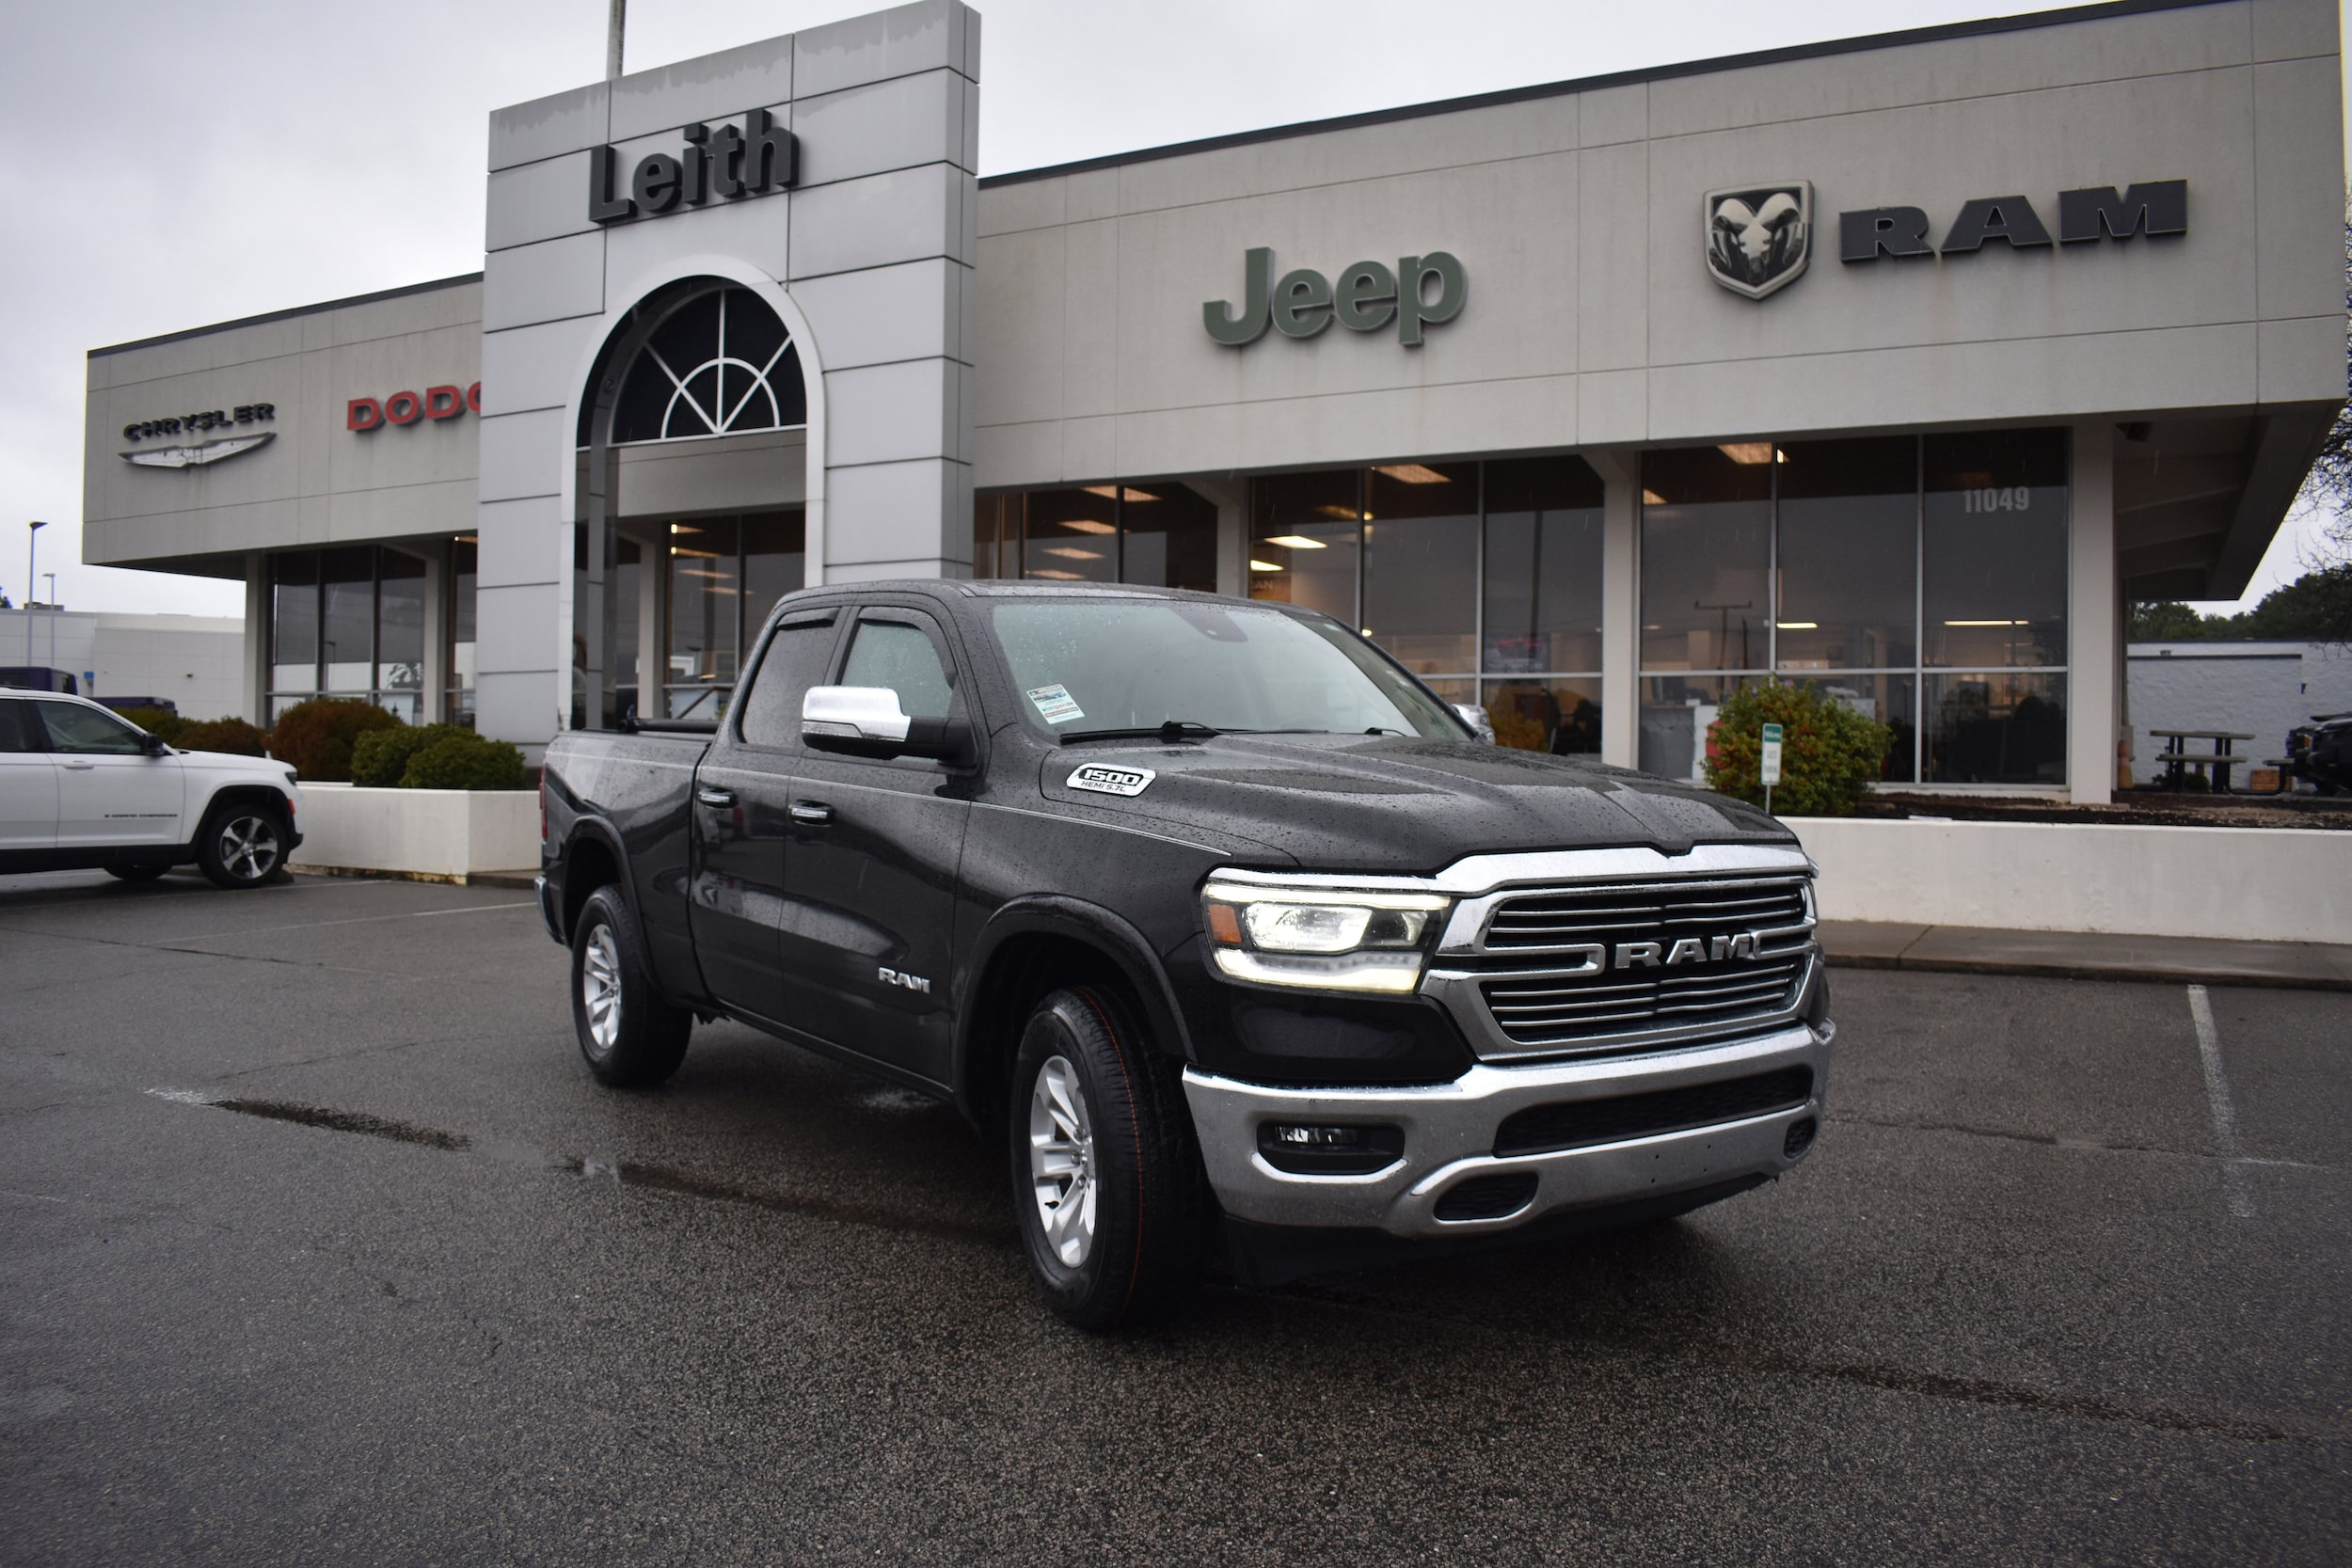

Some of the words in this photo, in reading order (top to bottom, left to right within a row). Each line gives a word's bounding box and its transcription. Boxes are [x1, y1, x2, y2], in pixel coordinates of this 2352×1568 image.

[589, 107, 800, 225] Leith
[1838, 179, 2188, 264] RAM
[1203, 246, 1469, 348] Jeep
[123, 403, 276, 440] CHRYSLER
[1963, 486, 2029, 513] 11049
[1081, 781, 1104, 789] HEMI
[1105, 784, 1125, 792] 5.7L
[1084, 768, 1140, 785] 1500
[1614, 933, 1751, 969] RAM
[879, 966, 930, 994] RAM
